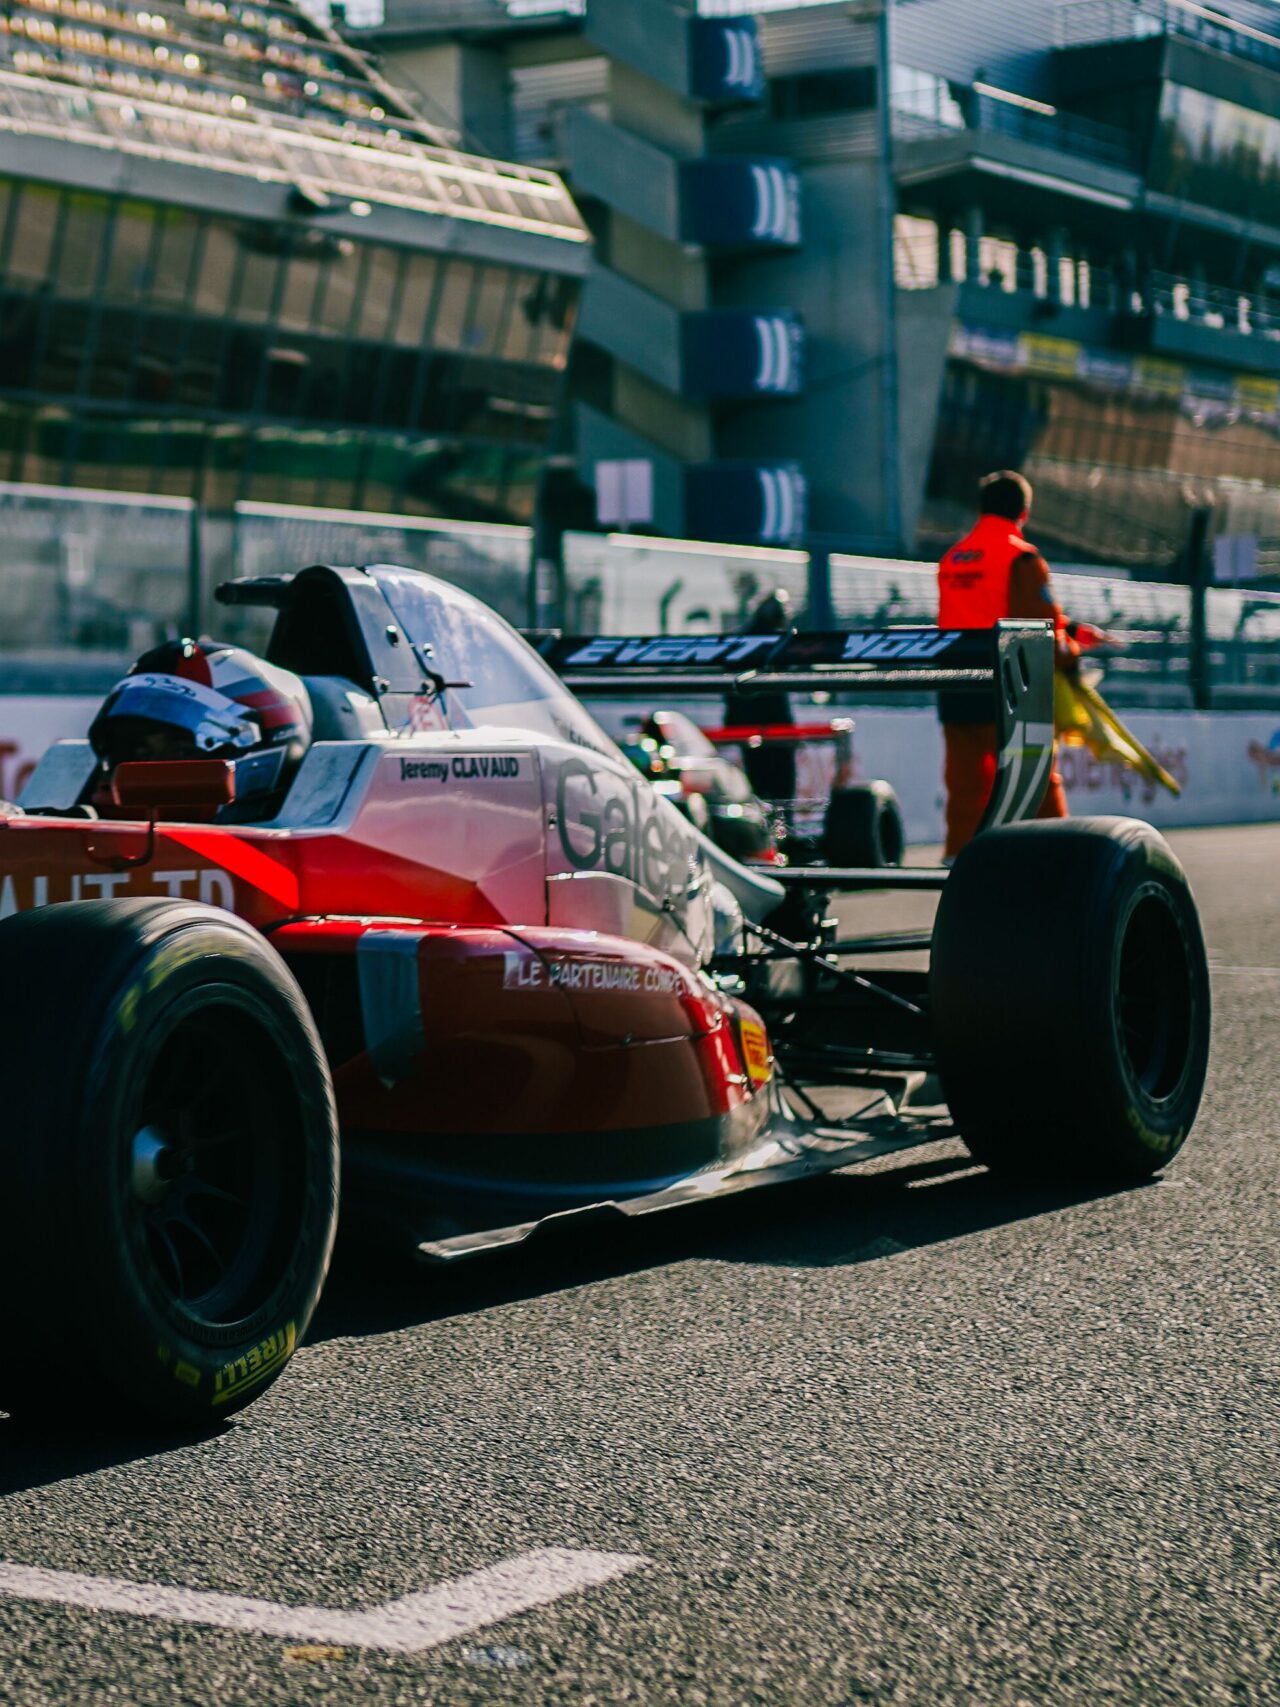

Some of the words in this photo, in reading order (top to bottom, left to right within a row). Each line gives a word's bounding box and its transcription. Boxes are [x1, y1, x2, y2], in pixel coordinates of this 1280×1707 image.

[566, 635, 780, 664] EVENT
[840, 632, 962, 660] YOU
[452, 757, 519, 779] CLAVAUD
[991, 721, 1054, 828] 17
[518, 961, 542, 987] LE
[211, 1320, 296, 1406] PIRELLI
